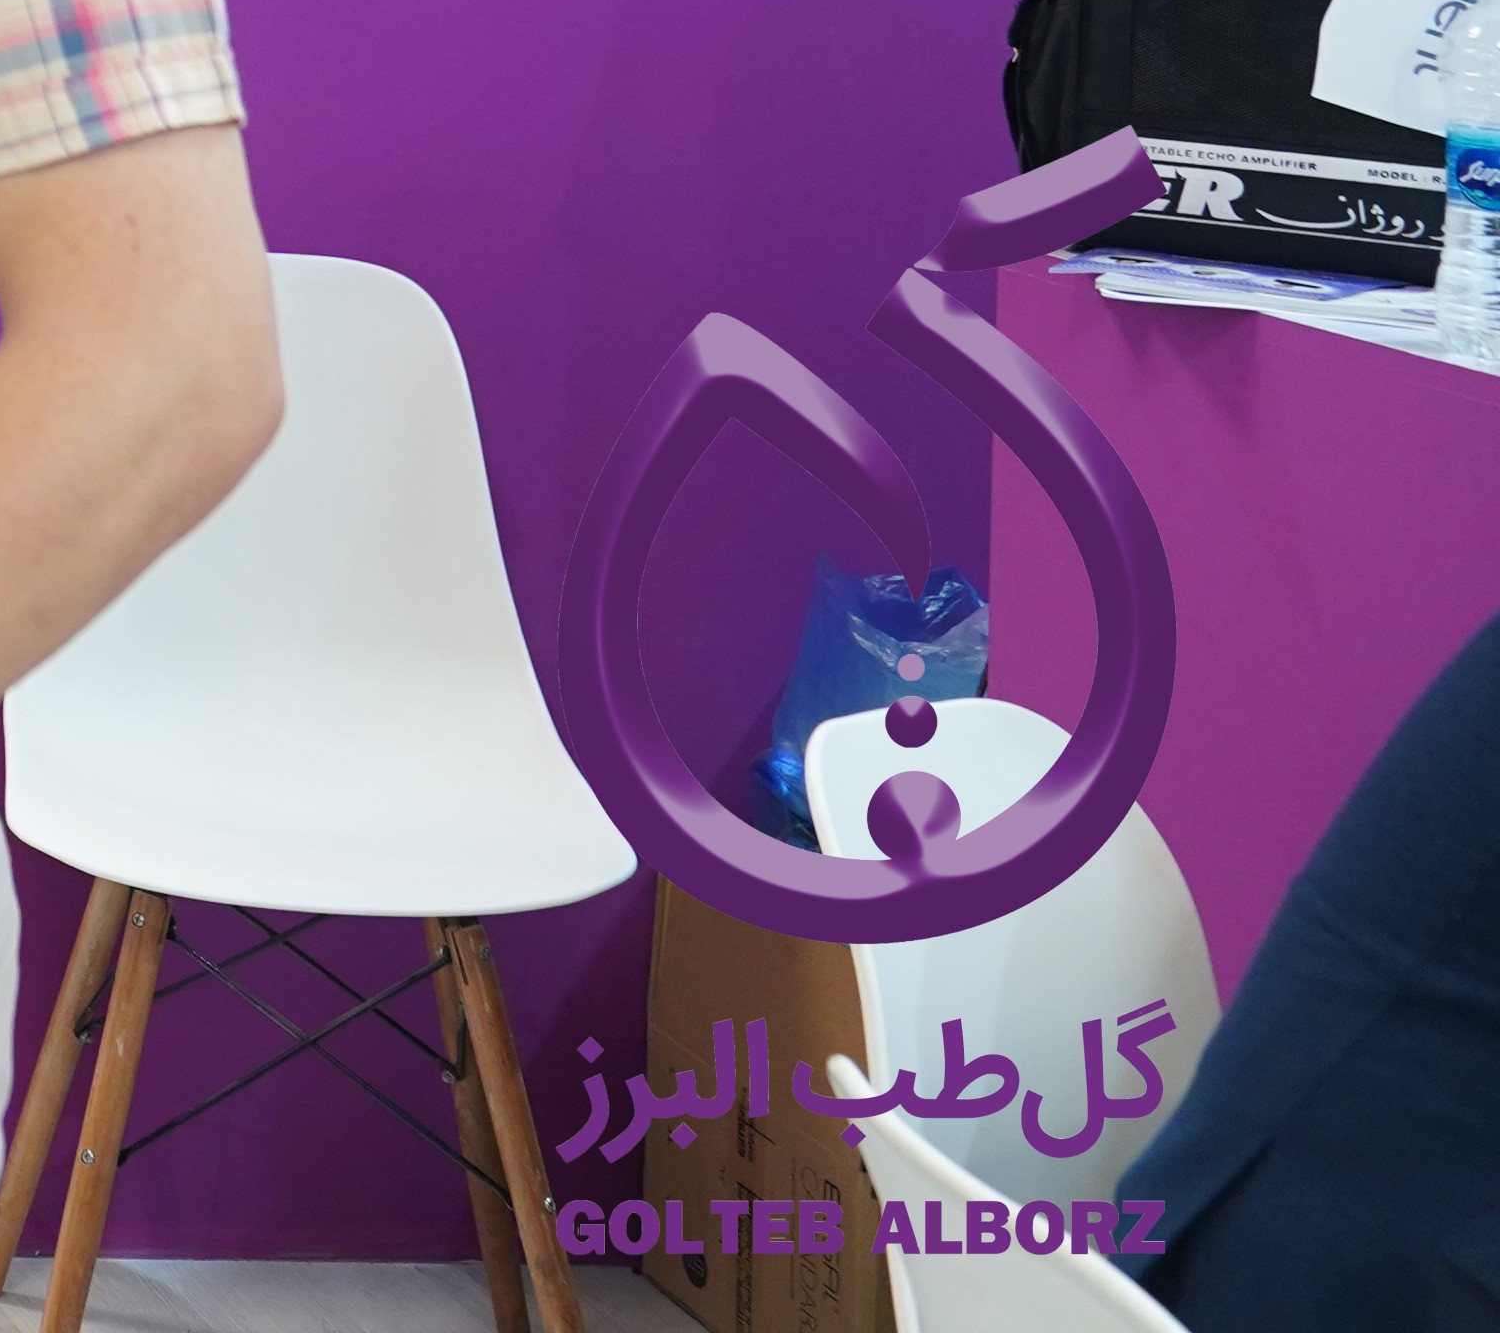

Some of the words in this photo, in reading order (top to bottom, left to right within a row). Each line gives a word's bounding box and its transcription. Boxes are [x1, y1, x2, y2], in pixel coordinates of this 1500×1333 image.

[1197, 149, 1237, 163] ECHO
[1240, 154, 1318, 173] AMPLIFIER
[1366, 167, 1419, 184] MODEL
